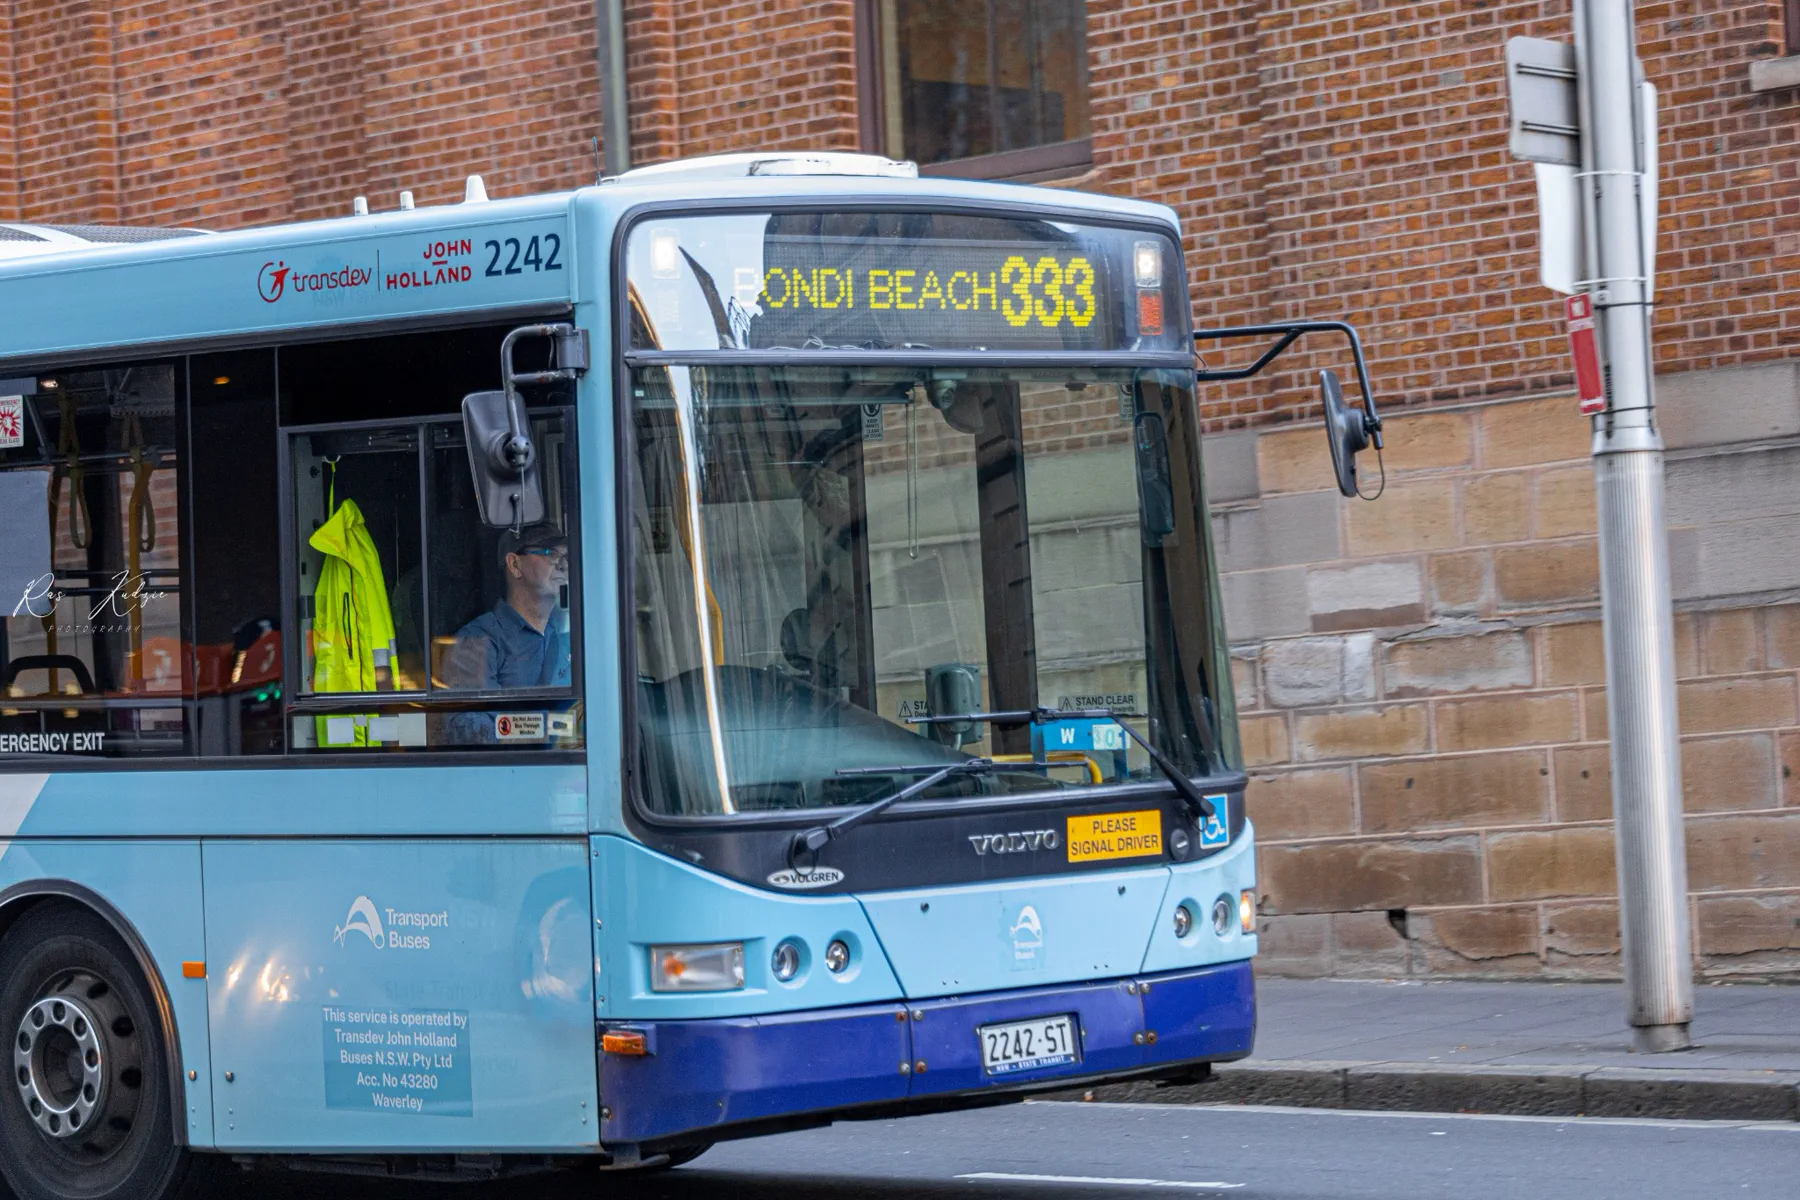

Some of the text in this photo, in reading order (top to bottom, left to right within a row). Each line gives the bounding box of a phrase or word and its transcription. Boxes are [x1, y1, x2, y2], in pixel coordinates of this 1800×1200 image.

[423, 239, 472, 260] JOHN
[485, 233, 562, 277] 2242
[292, 266, 372, 292] transdev
[386, 266, 472, 290] HOLLAND
[734, 256, 1095, 327] BONDI BEACH 333
[1075, 694, 1134, 706] STAND CLEAR
[0, 732, 105, 751] ERGENCY EXIT
[1060, 728, 1075, 744] W
[1092, 817, 1137, 835] PLEASE
[968, 829, 1060, 856] VOLVO
[1071, 834, 1159, 856] SIGNAL DRIVER
[790, 872, 839, 883] VOLGREN
[385, 907, 449, 930] Transport
[389, 931, 431, 949] Buses
[323, 1008, 467, 1029] This service is operated by
[334, 1029, 457, 1047] Transdev John Holland
[340, 1050, 453, 1070] Buses N.S.W. Pty Ltd
[356, 1072, 438, 1089] Acc. No 43280
[372, 1093, 423, 1111] Waverley
